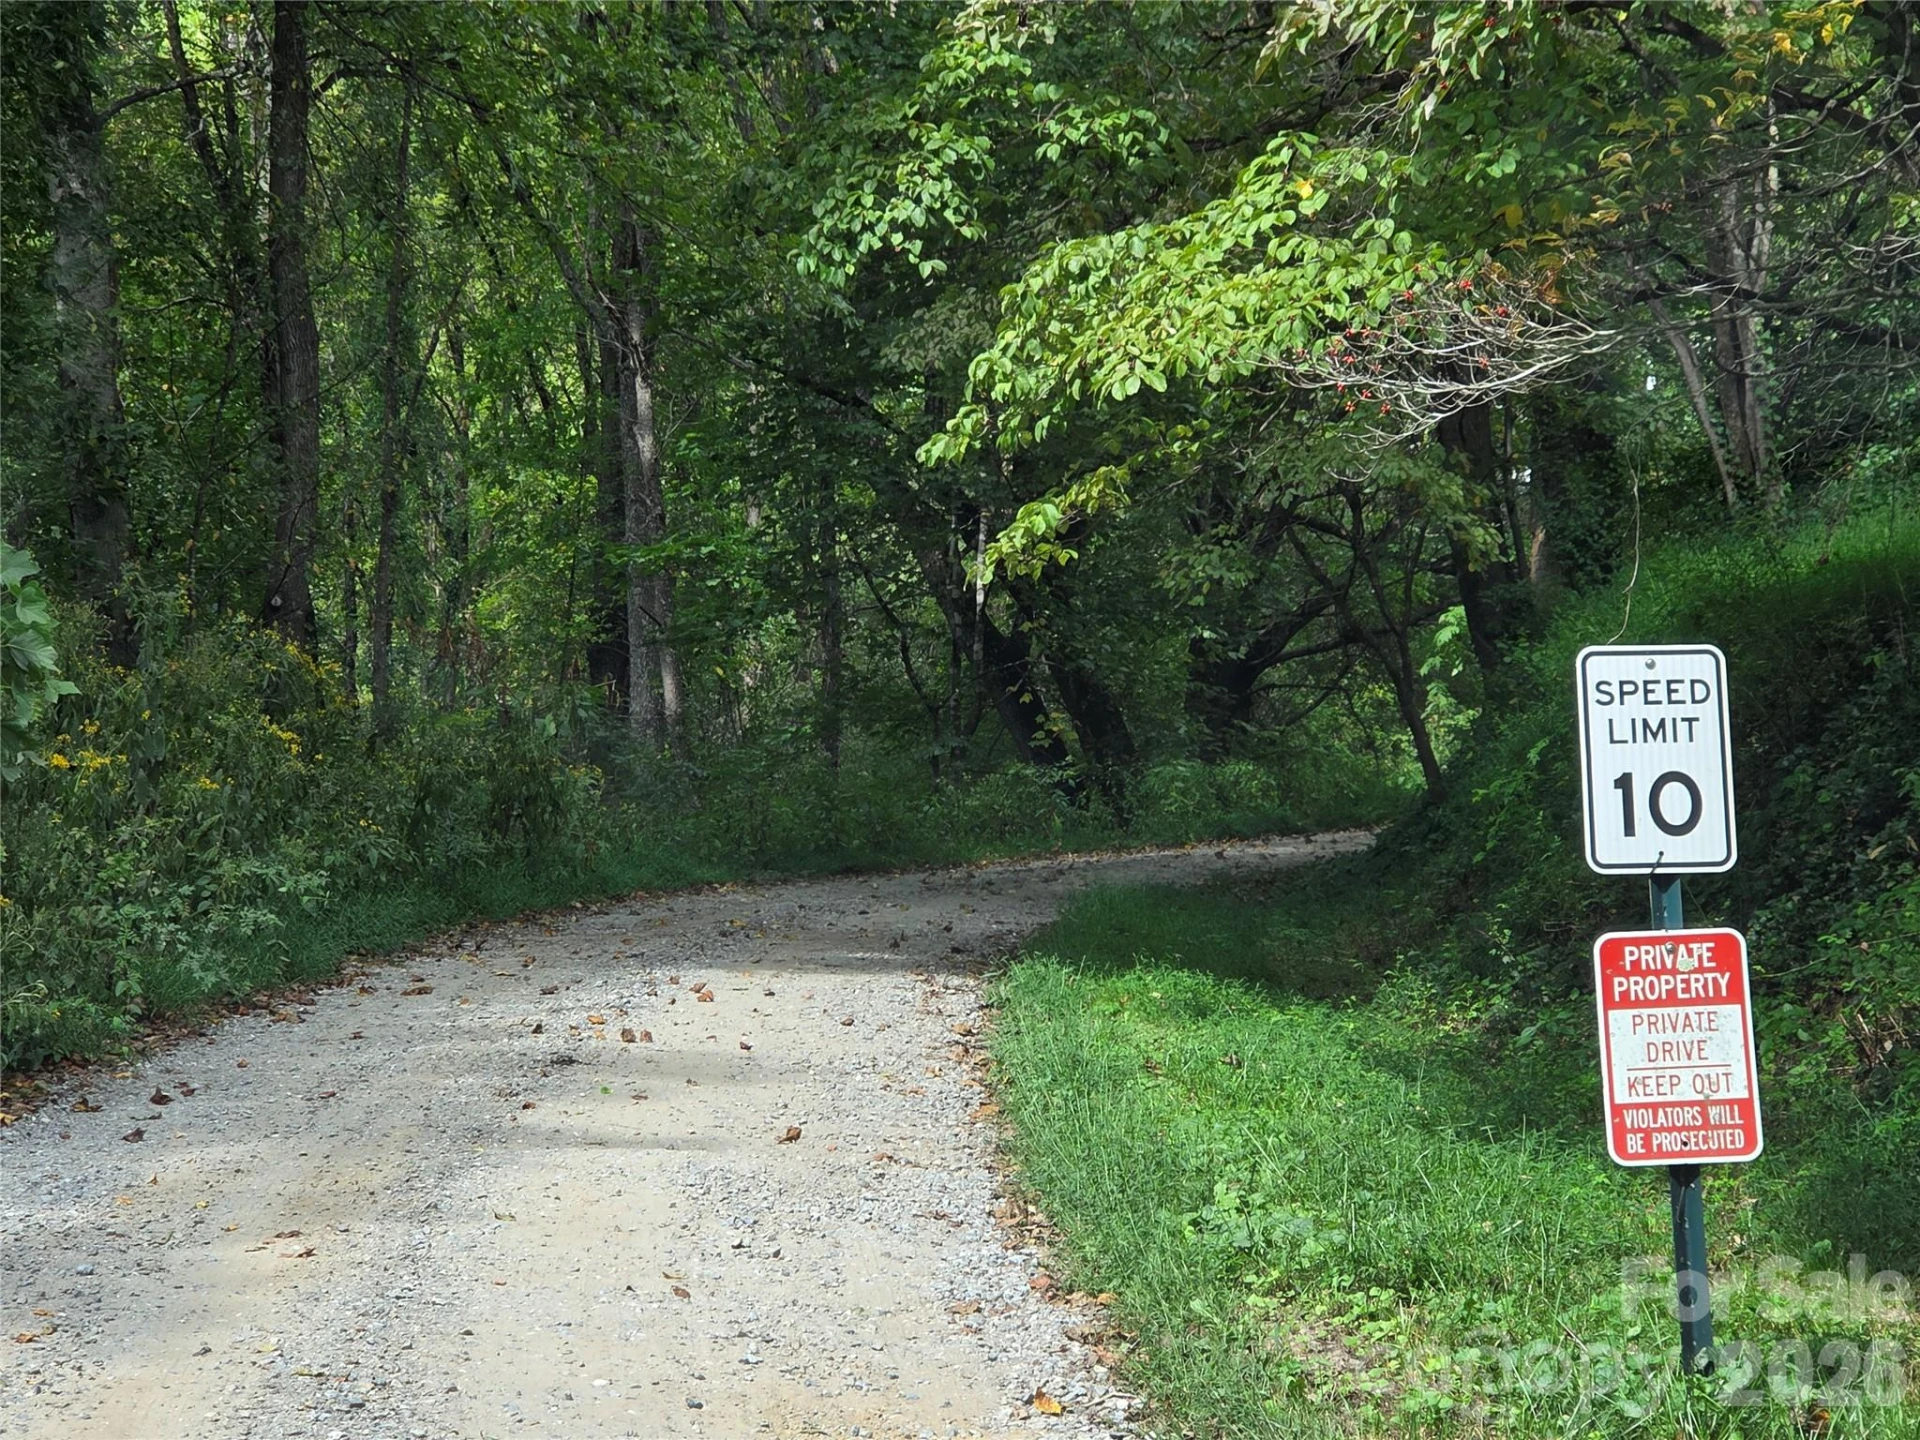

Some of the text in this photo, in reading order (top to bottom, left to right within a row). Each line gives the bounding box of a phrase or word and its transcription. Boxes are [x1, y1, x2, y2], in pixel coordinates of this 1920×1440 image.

[1595, 679, 1711, 706] SPEED
[1608, 717, 1700, 744] LIMIT
[1613, 770, 1703, 838] 10
[1624, 942, 1716, 971] PRIVATE
[1613, 972, 1730, 1002] PROPERTY
[1631, 1011, 1719, 1035] PRIVATE
[1646, 1040, 1709, 1063] DRIVE
[1627, 1072, 1733, 1097] KEEP OUT
[1623, 1104, 1744, 1129] VIOLATORS WILL
[1627, 1129, 1745, 1153] BE PROSECUTED
